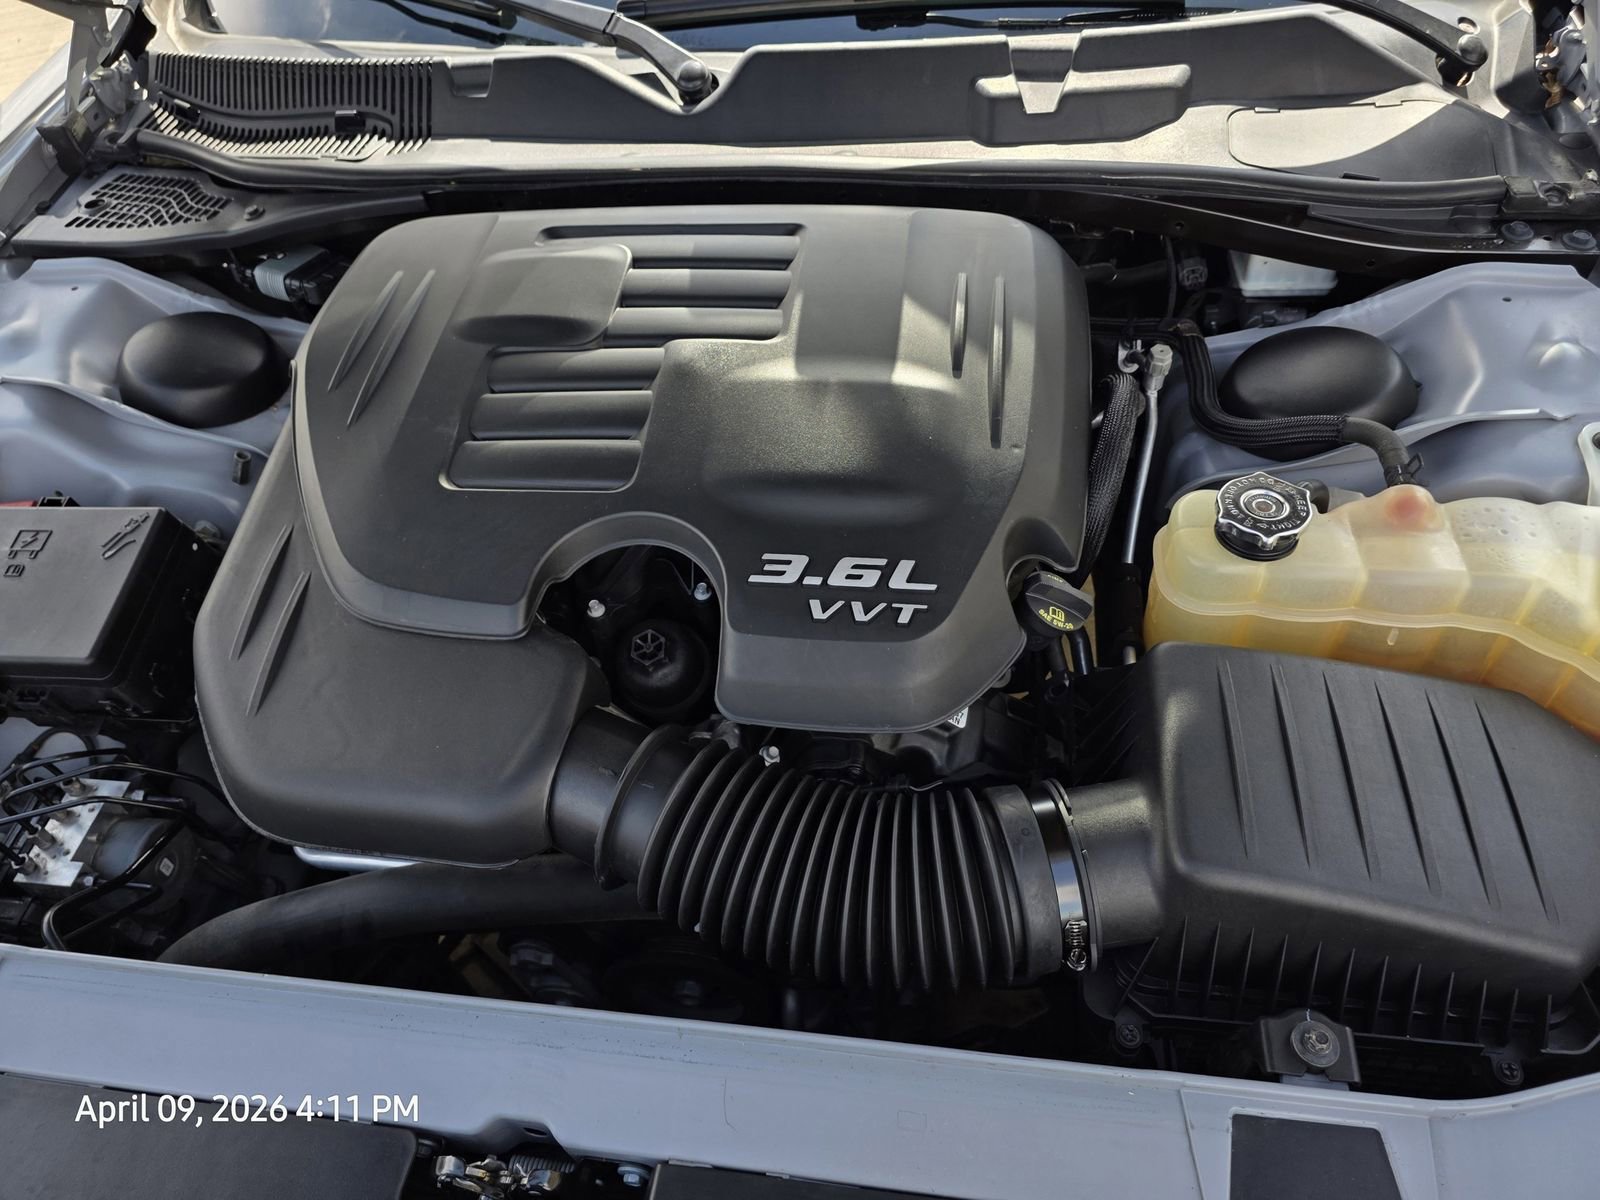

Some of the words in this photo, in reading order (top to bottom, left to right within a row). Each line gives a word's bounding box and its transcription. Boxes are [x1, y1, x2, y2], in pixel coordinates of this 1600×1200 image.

[1293, 494, 1307, 517] KEEP
[1270, 519, 1301, 531] TIGHT
[748, 553, 938, 591] 3.6L
[809, 599, 928, 624] VVT
[1038, 608, 1053, 622] SAE
[1052, 619, 1074, 630] 5W-20
